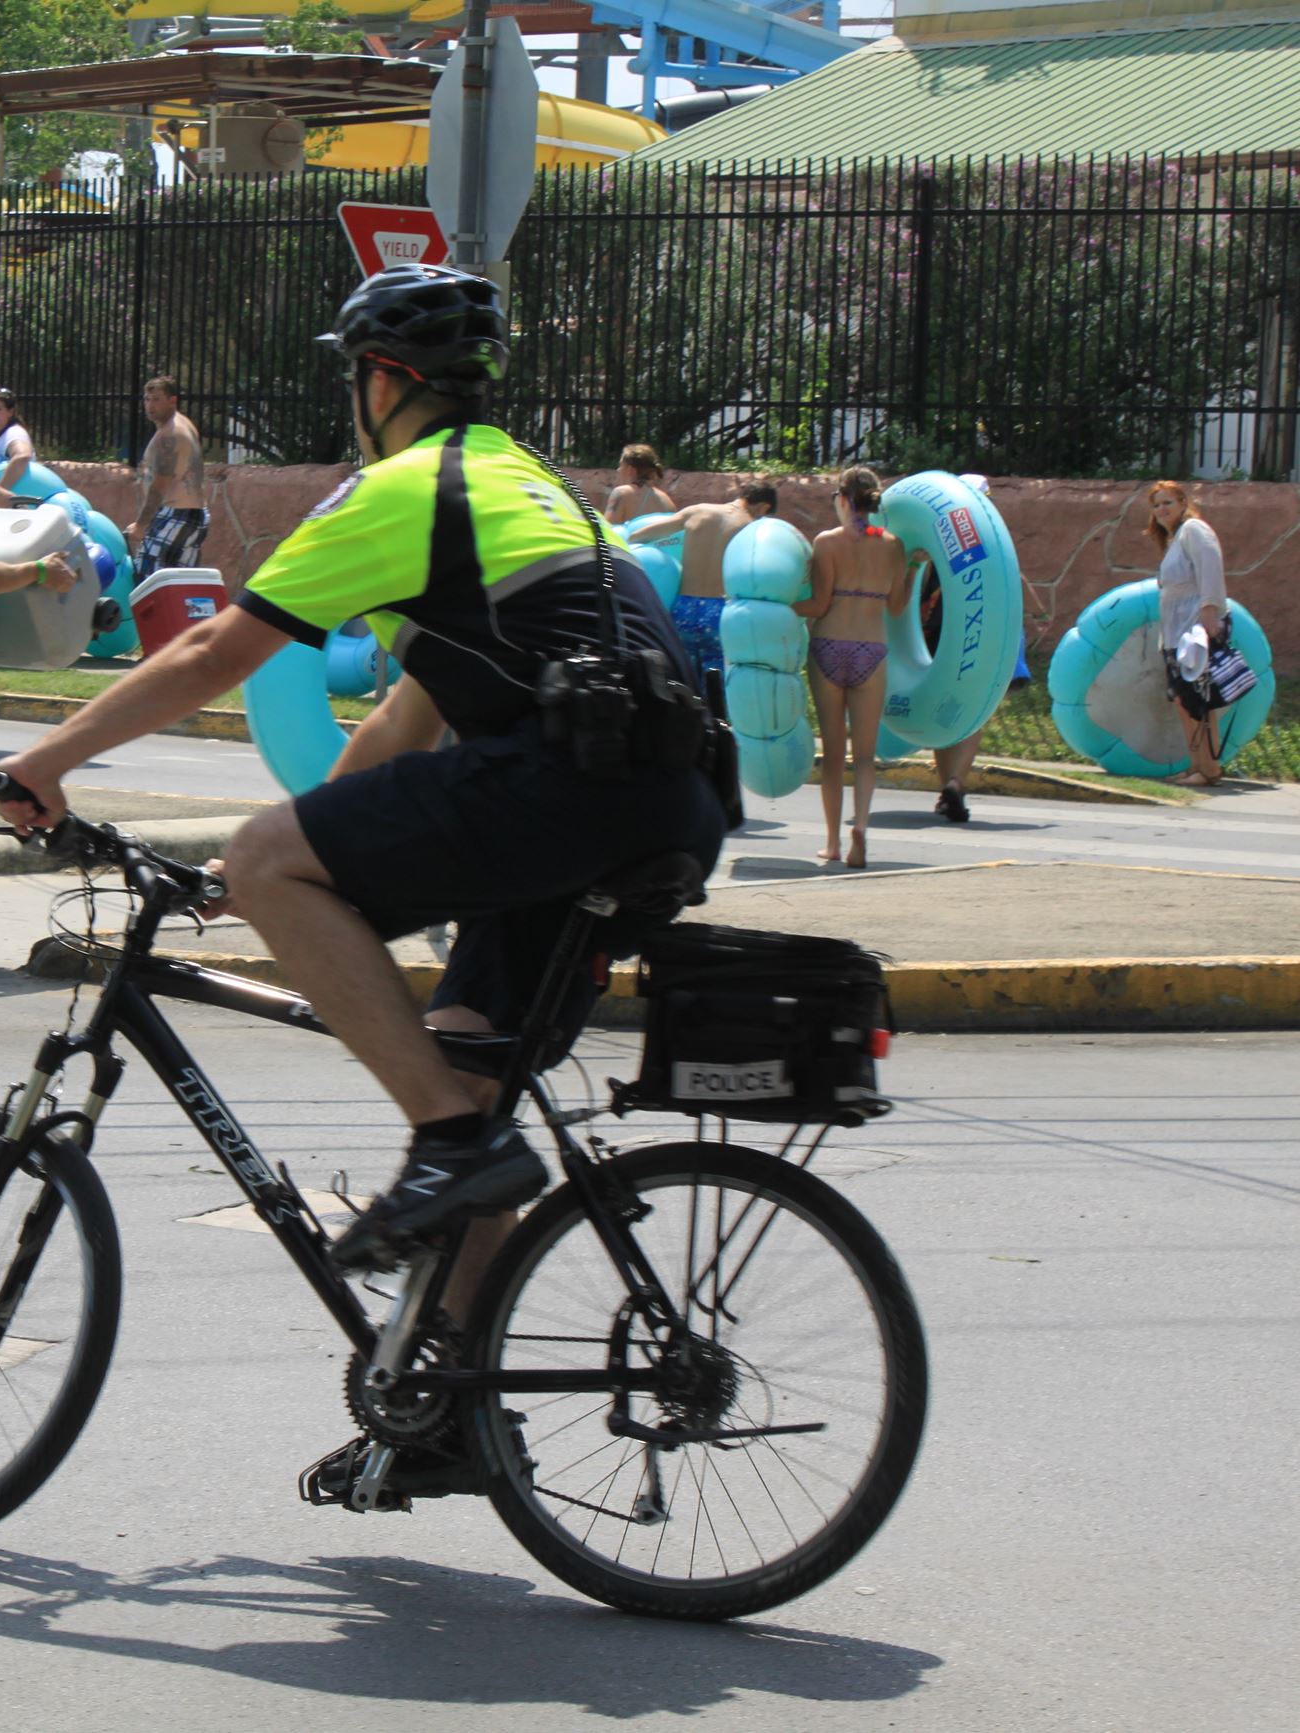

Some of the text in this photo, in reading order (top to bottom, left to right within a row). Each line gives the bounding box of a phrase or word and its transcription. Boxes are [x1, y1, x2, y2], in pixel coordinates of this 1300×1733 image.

[382, 241, 419, 258] YIELD
[937, 515, 960, 559] TEXAS
[953, 508, 978, 550] TUBES
[956, 567, 984, 681] TEXAS
[688, 1071, 776, 1093] POLICE
